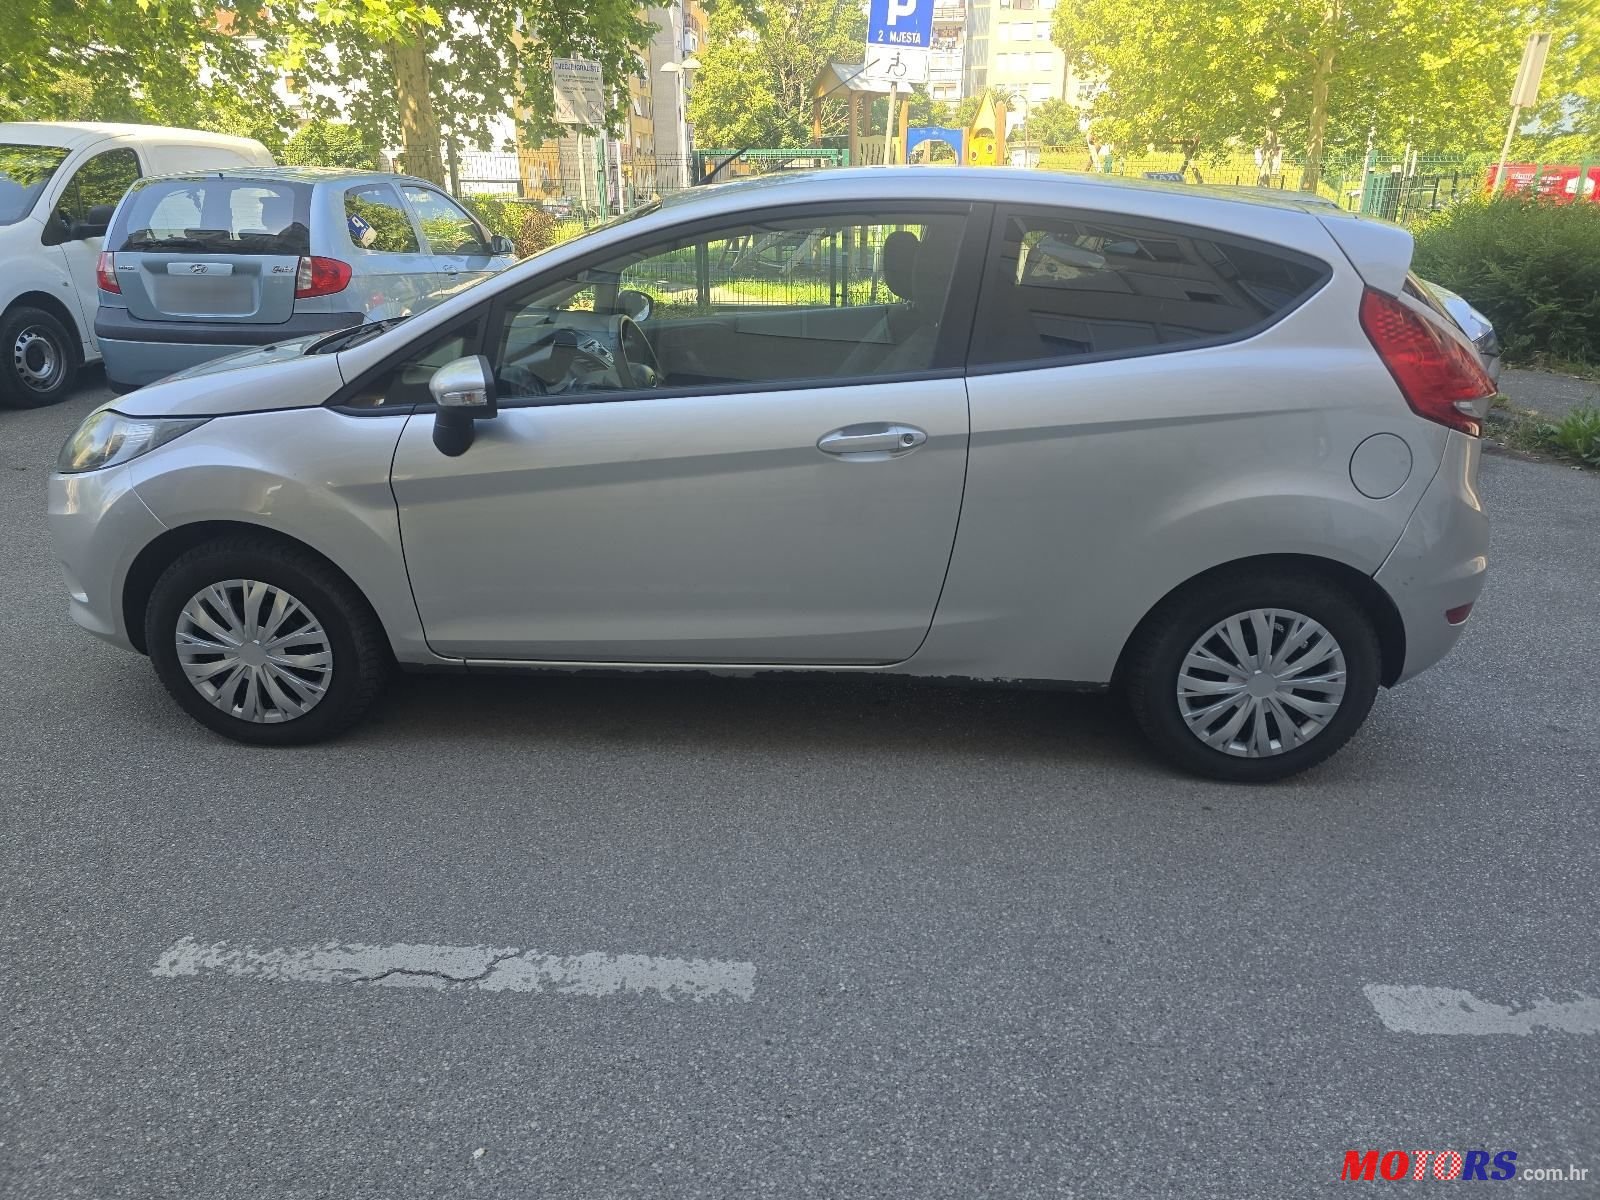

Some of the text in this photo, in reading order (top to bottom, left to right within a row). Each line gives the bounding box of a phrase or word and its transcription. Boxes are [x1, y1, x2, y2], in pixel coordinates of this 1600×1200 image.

[887, 0, 917, 26] P
[878, 30, 921, 44] 2 MJESTA
